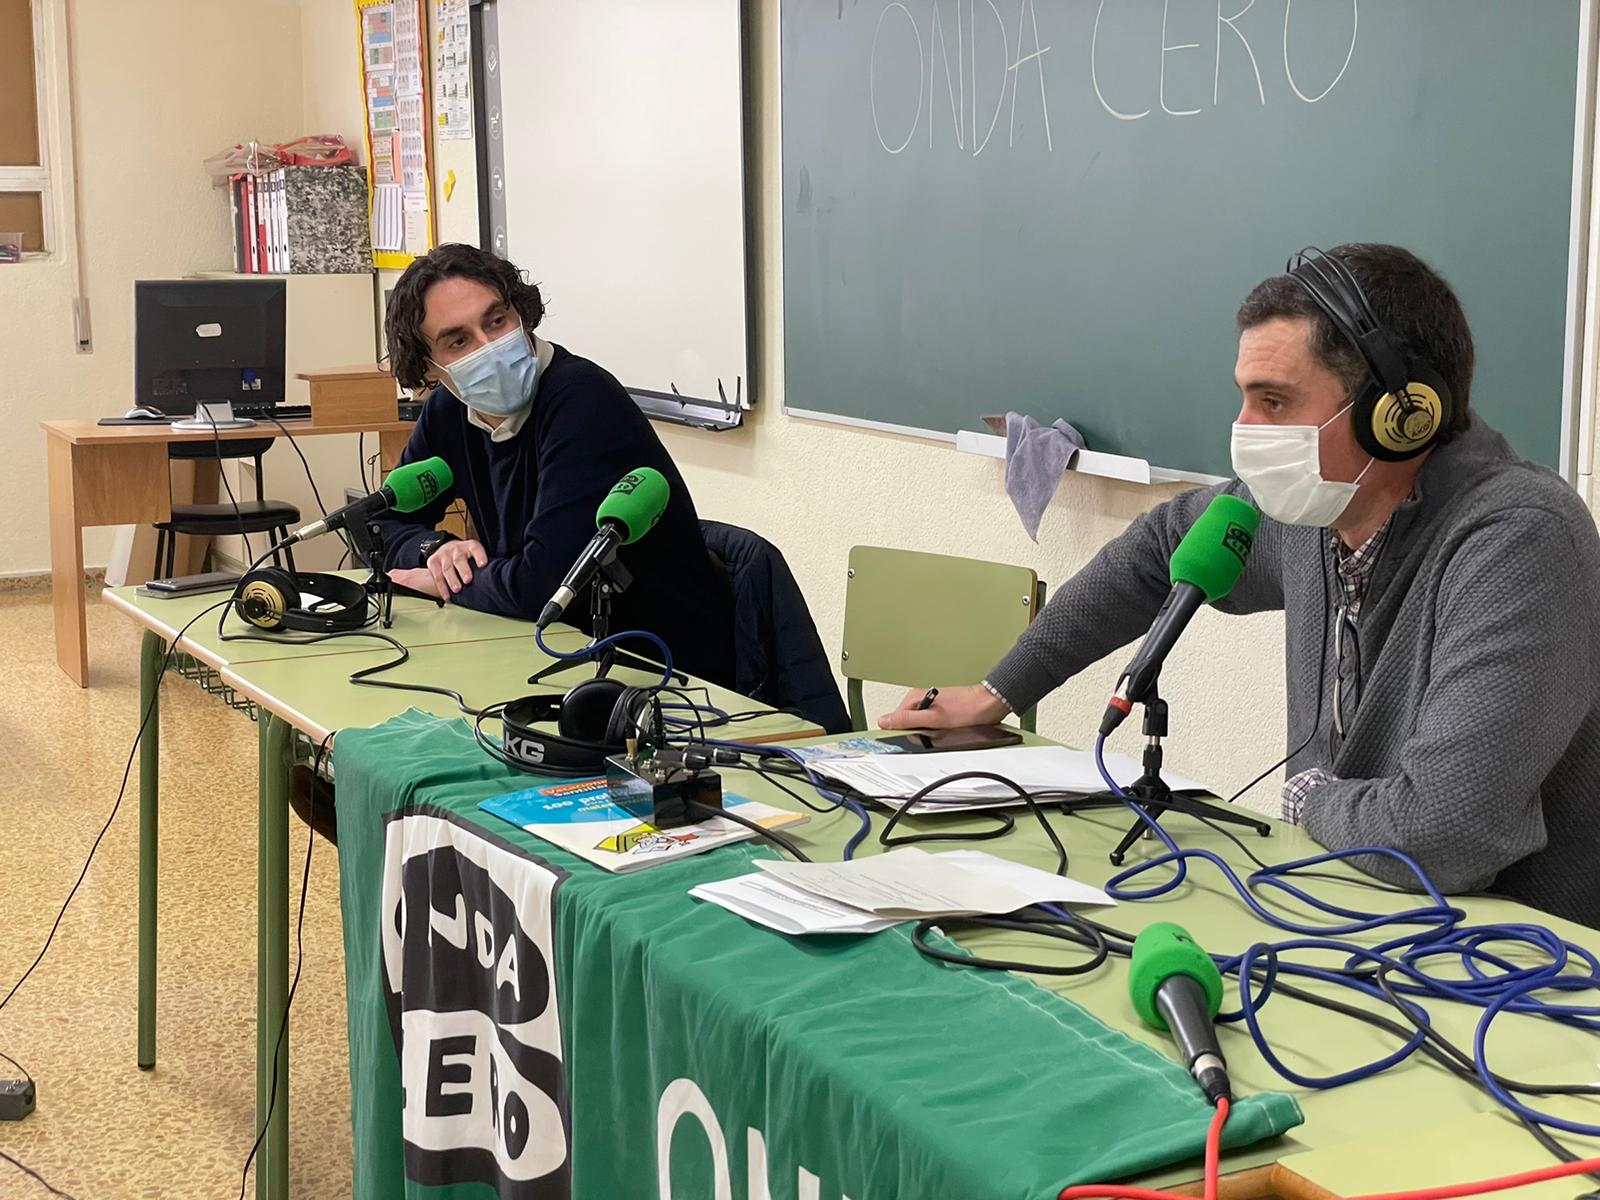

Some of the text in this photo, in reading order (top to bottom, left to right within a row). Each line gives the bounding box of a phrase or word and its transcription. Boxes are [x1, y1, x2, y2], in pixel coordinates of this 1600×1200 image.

[870, 0, 1358, 157] ONDA CERO
[542, 801, 575, 811] 100
[402, 887, 521, 1003] NDA
